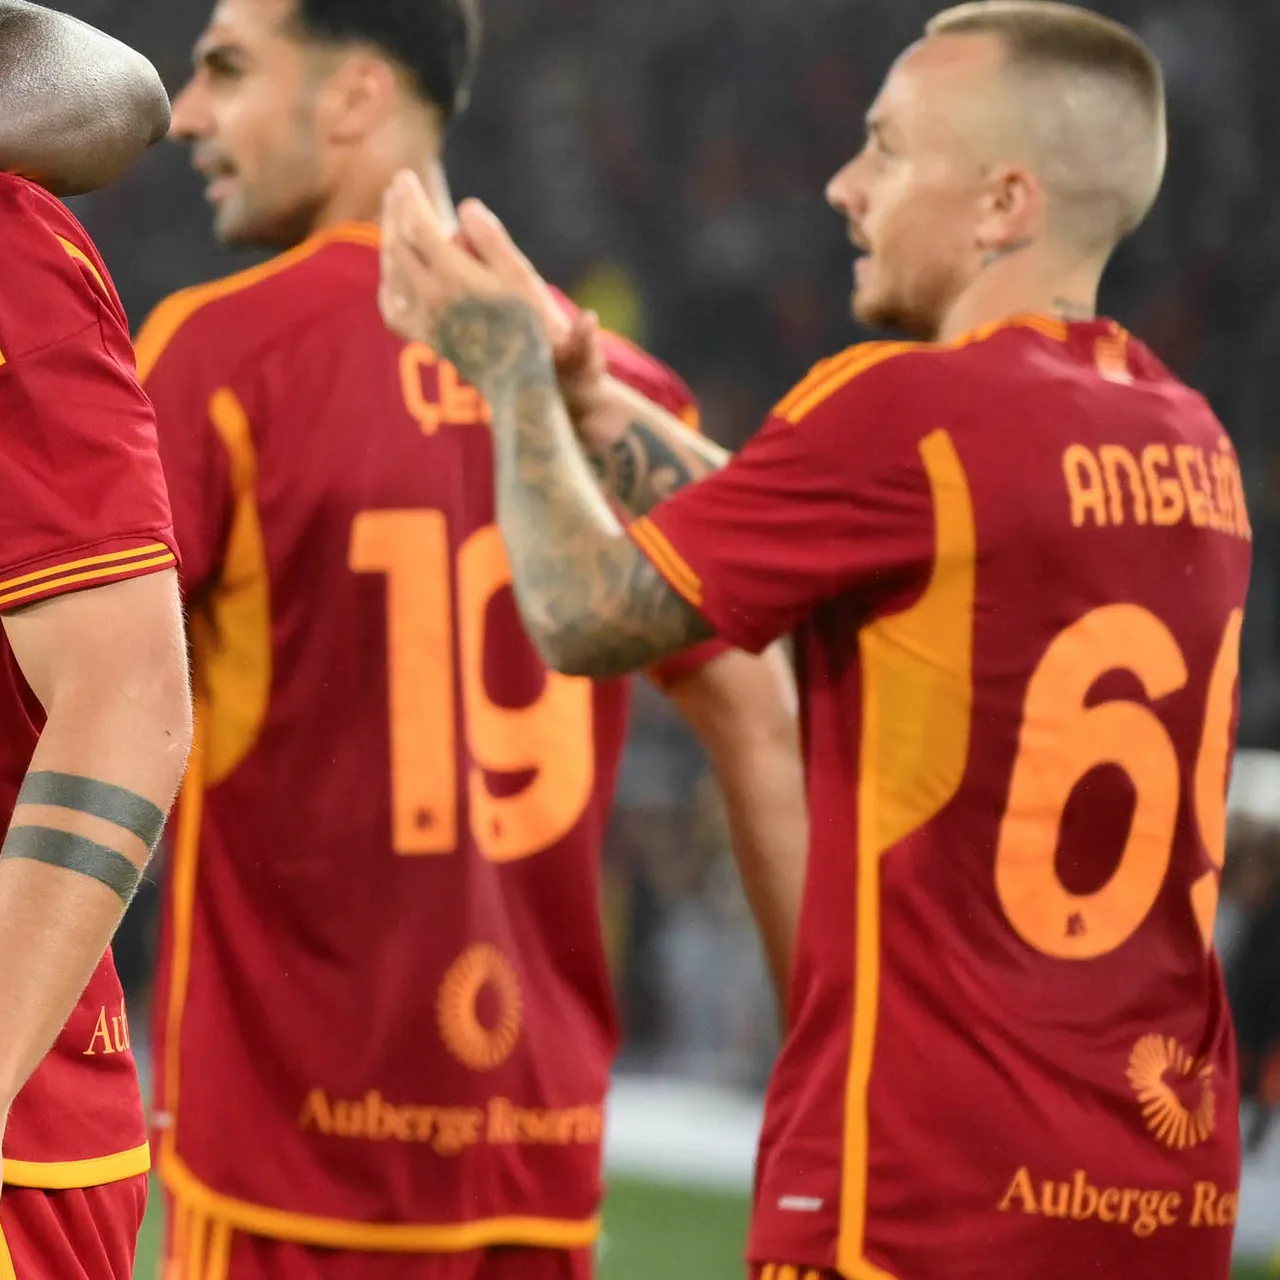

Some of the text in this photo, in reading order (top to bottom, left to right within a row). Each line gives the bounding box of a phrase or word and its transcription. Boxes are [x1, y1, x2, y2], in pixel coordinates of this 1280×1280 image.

[349, 509, 595, 862] 19
[997, 1166, 1241, 1238] Auberge Re
